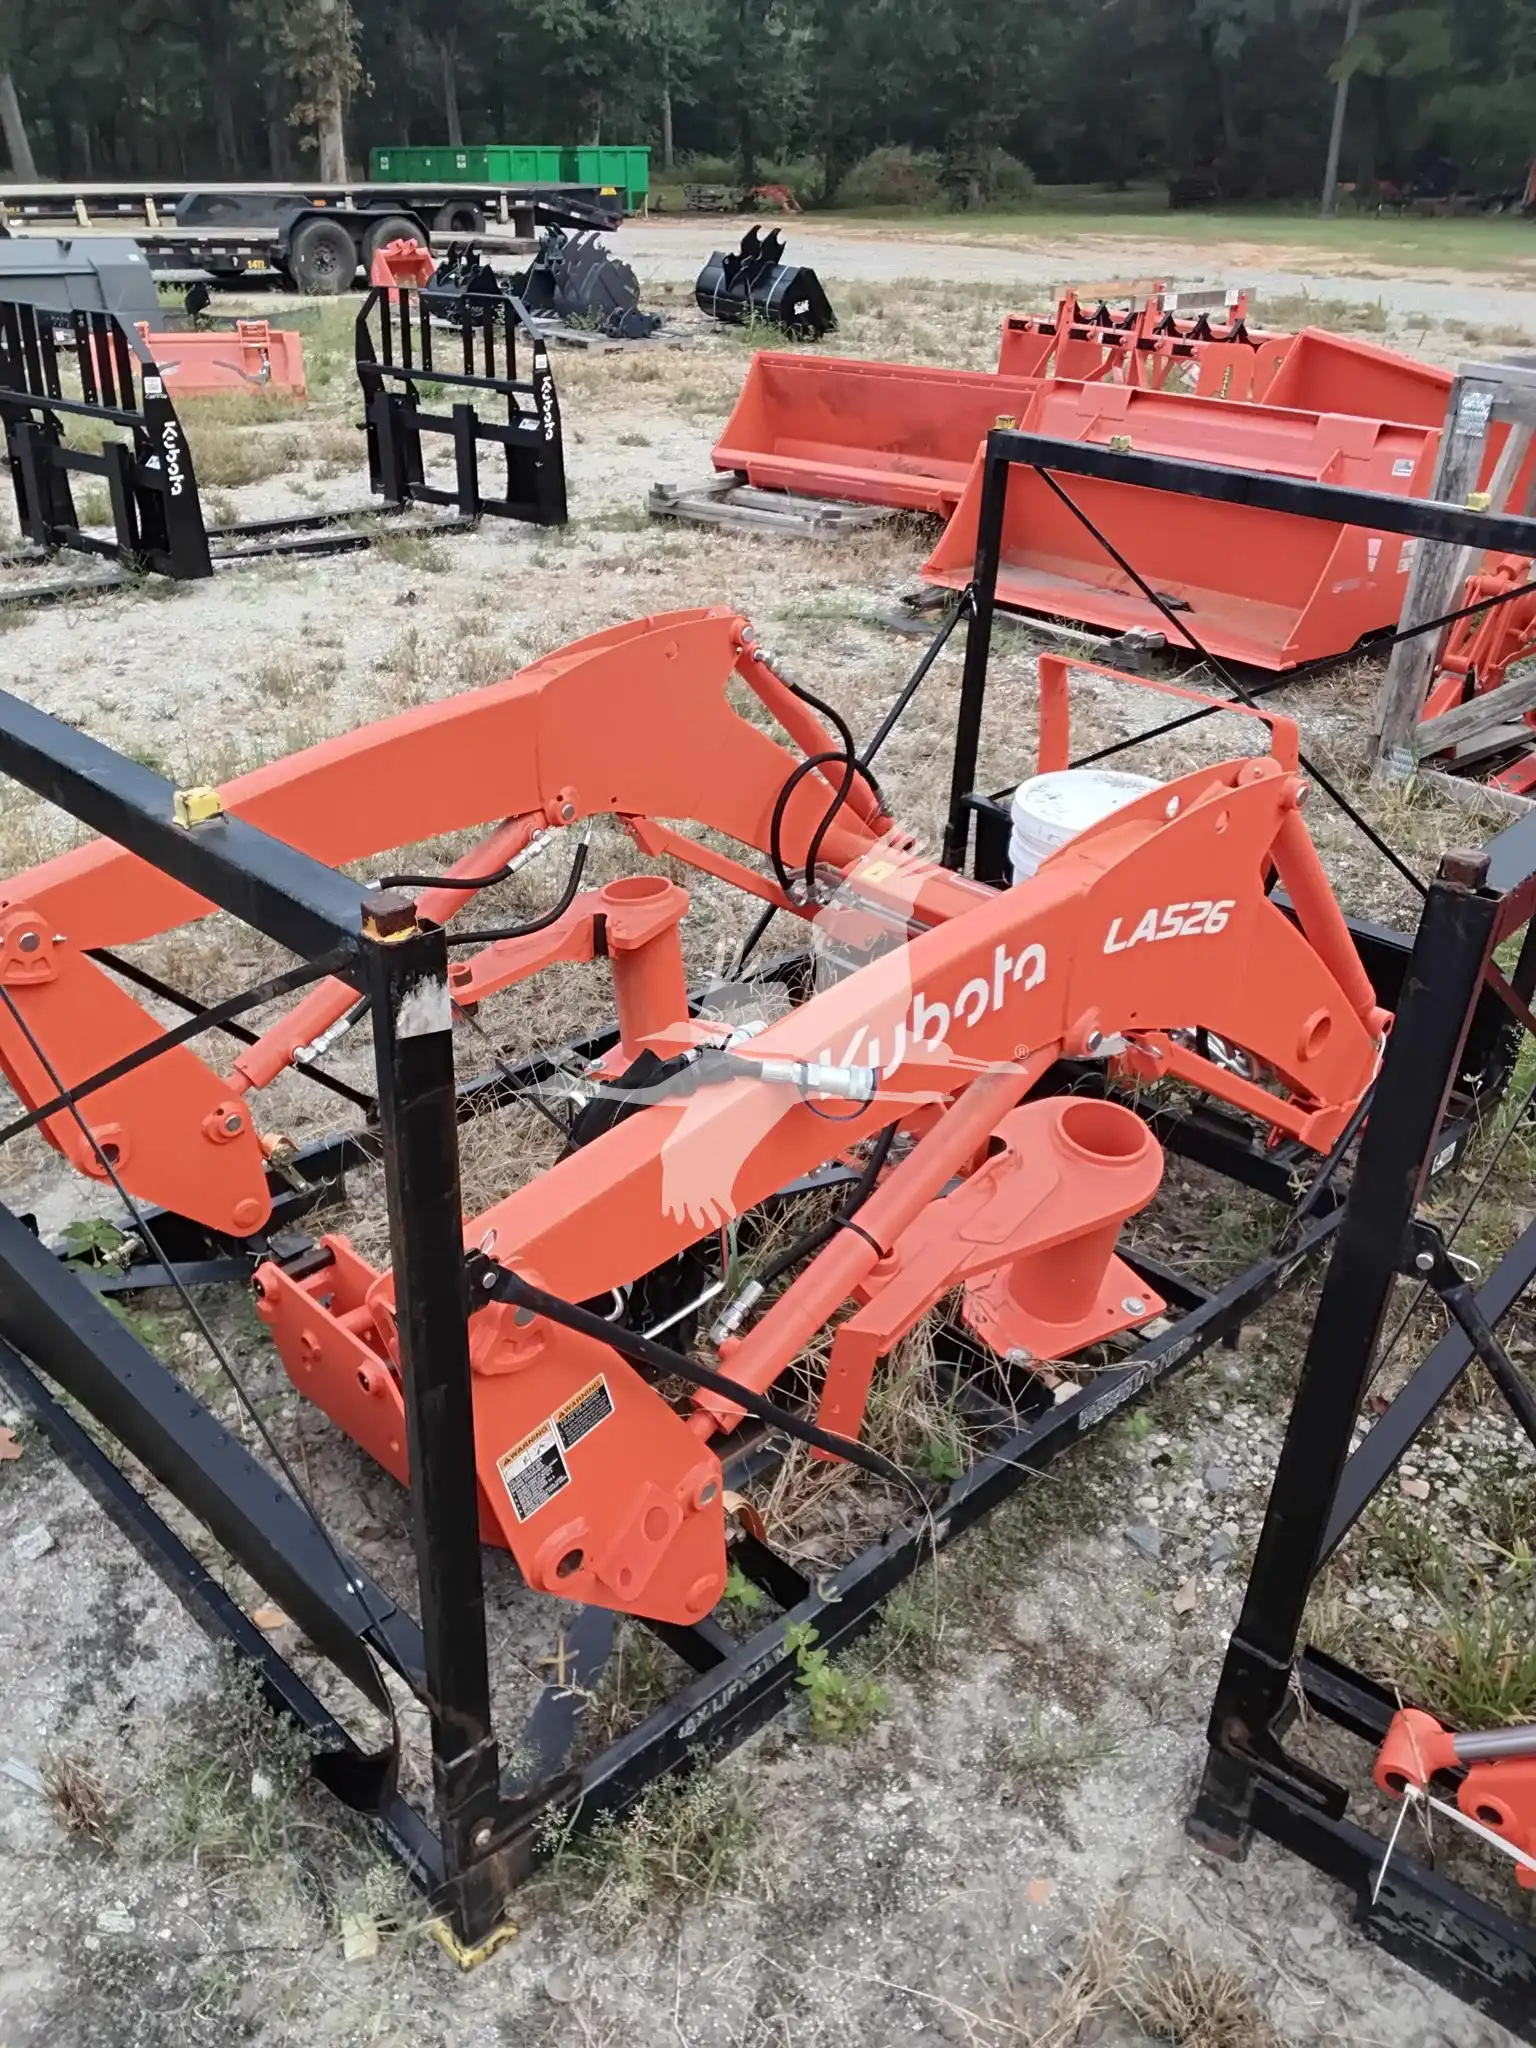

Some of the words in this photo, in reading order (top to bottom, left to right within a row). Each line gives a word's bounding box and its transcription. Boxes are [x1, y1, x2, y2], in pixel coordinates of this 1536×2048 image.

[541, 375, 555, 441] Kubota
[162, 420, 185, 496] Kubota
[1103, 899, 1237, 955] LA526
[820, 943, 1046, 1101] Kubota
[563, 1379, 601, 1412] WARNING
[509, 1425, 549, 1461] WARNING
